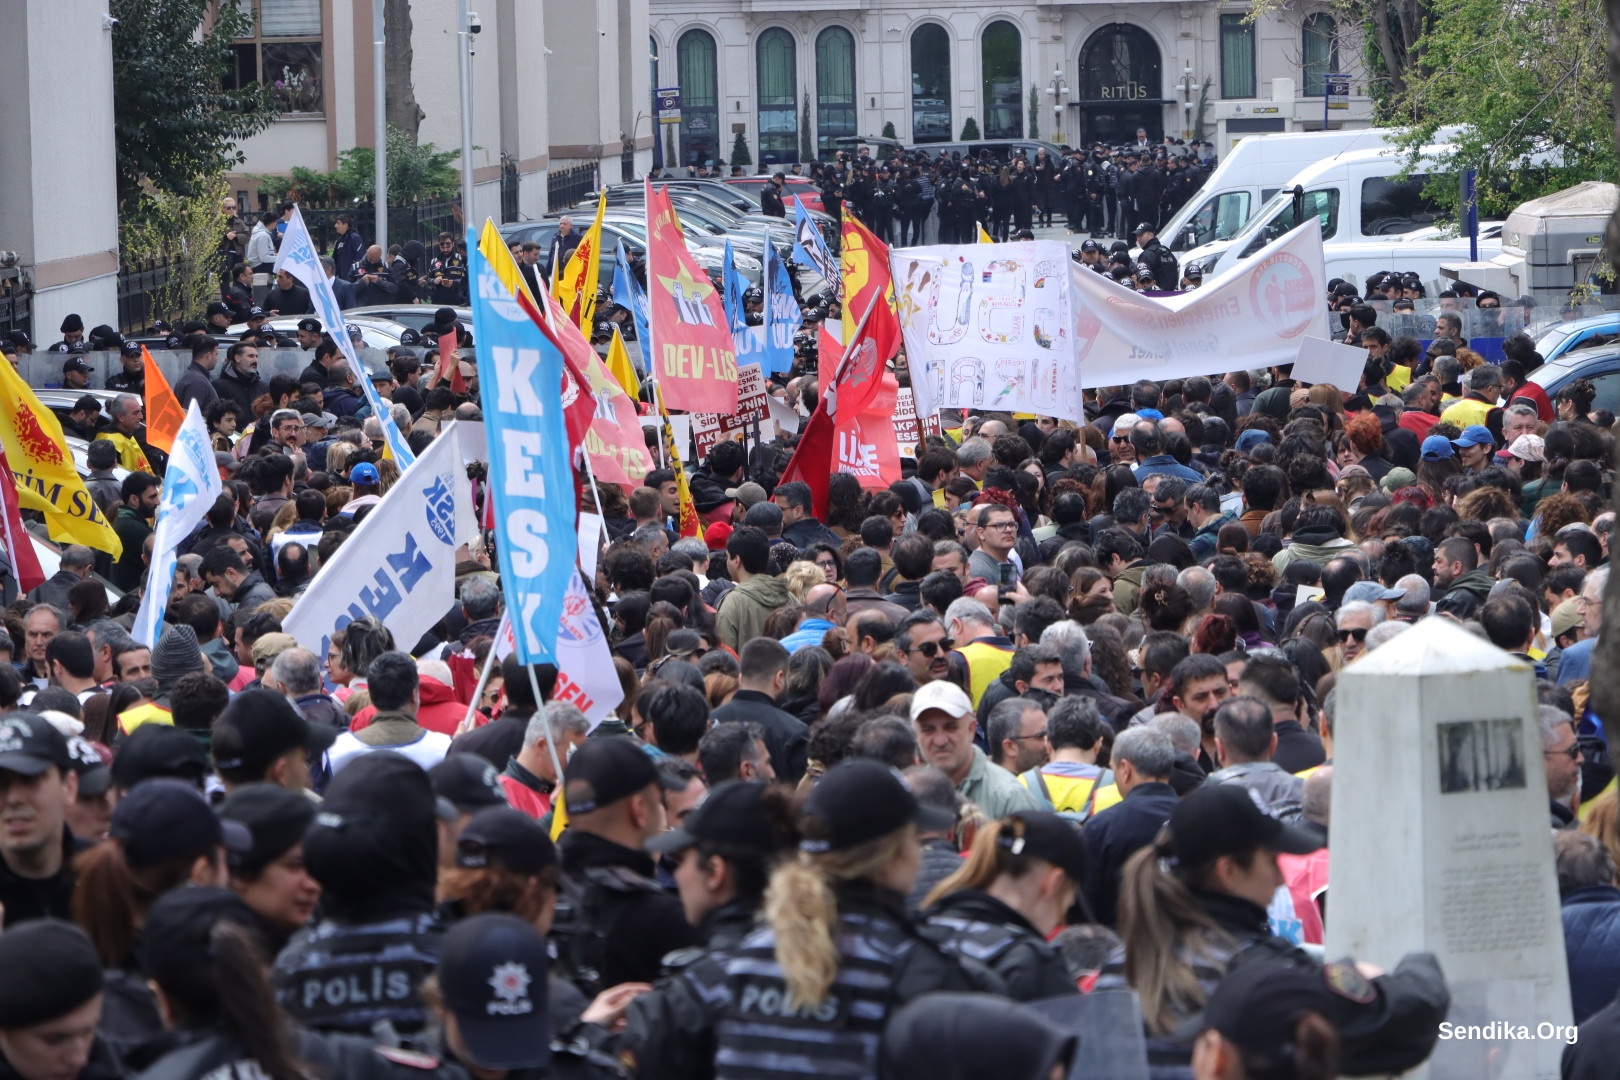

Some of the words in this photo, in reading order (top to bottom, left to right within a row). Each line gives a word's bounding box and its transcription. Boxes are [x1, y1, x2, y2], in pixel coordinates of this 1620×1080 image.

[1101, 81, 1147, 100] RITUS
[663, 344, 738, 382] DEV-LİS
[67, 490, 110, 529] SE
[492, 346, 549, 655] KESK
[303, 967, 411, 1008] POLİS
